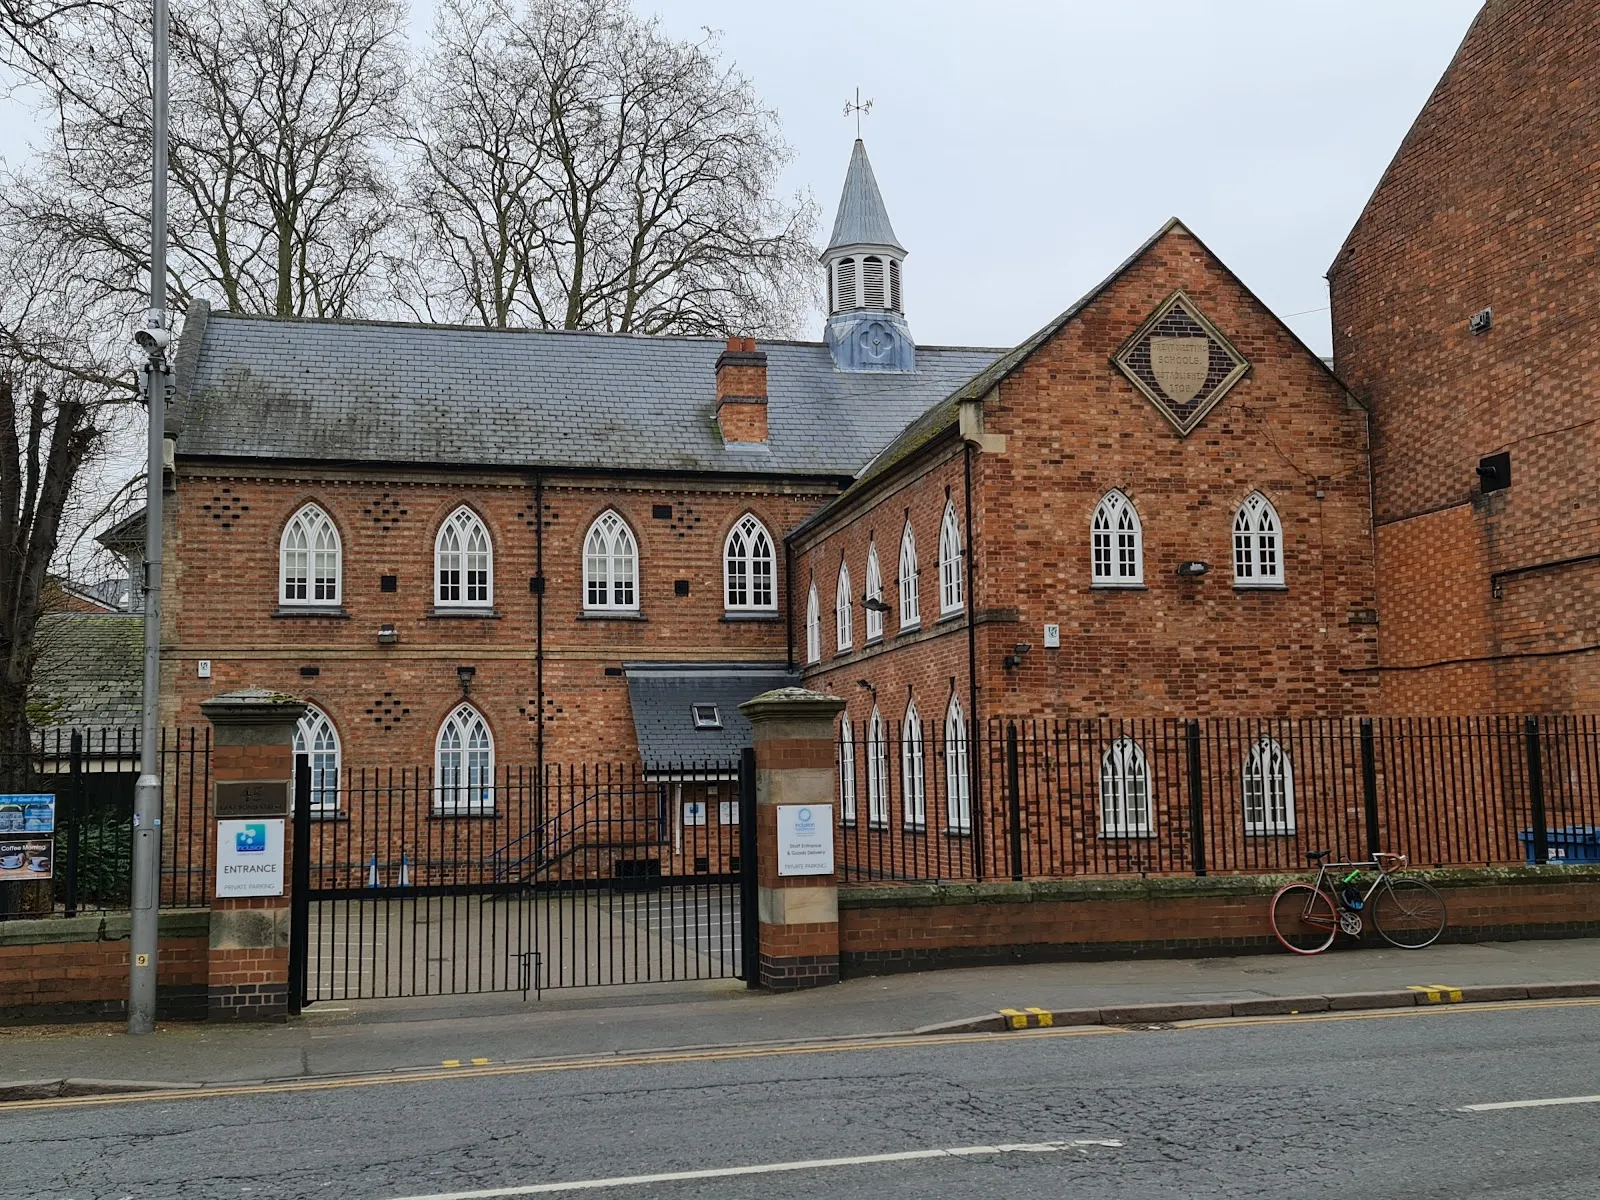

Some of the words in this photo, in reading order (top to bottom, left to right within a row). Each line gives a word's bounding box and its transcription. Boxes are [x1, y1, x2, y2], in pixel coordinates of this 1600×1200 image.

[22, 844, 47, 852] Morning
[224, 864, 277, 874] ENTRANCE
[138, 955, 146, 965] 9
